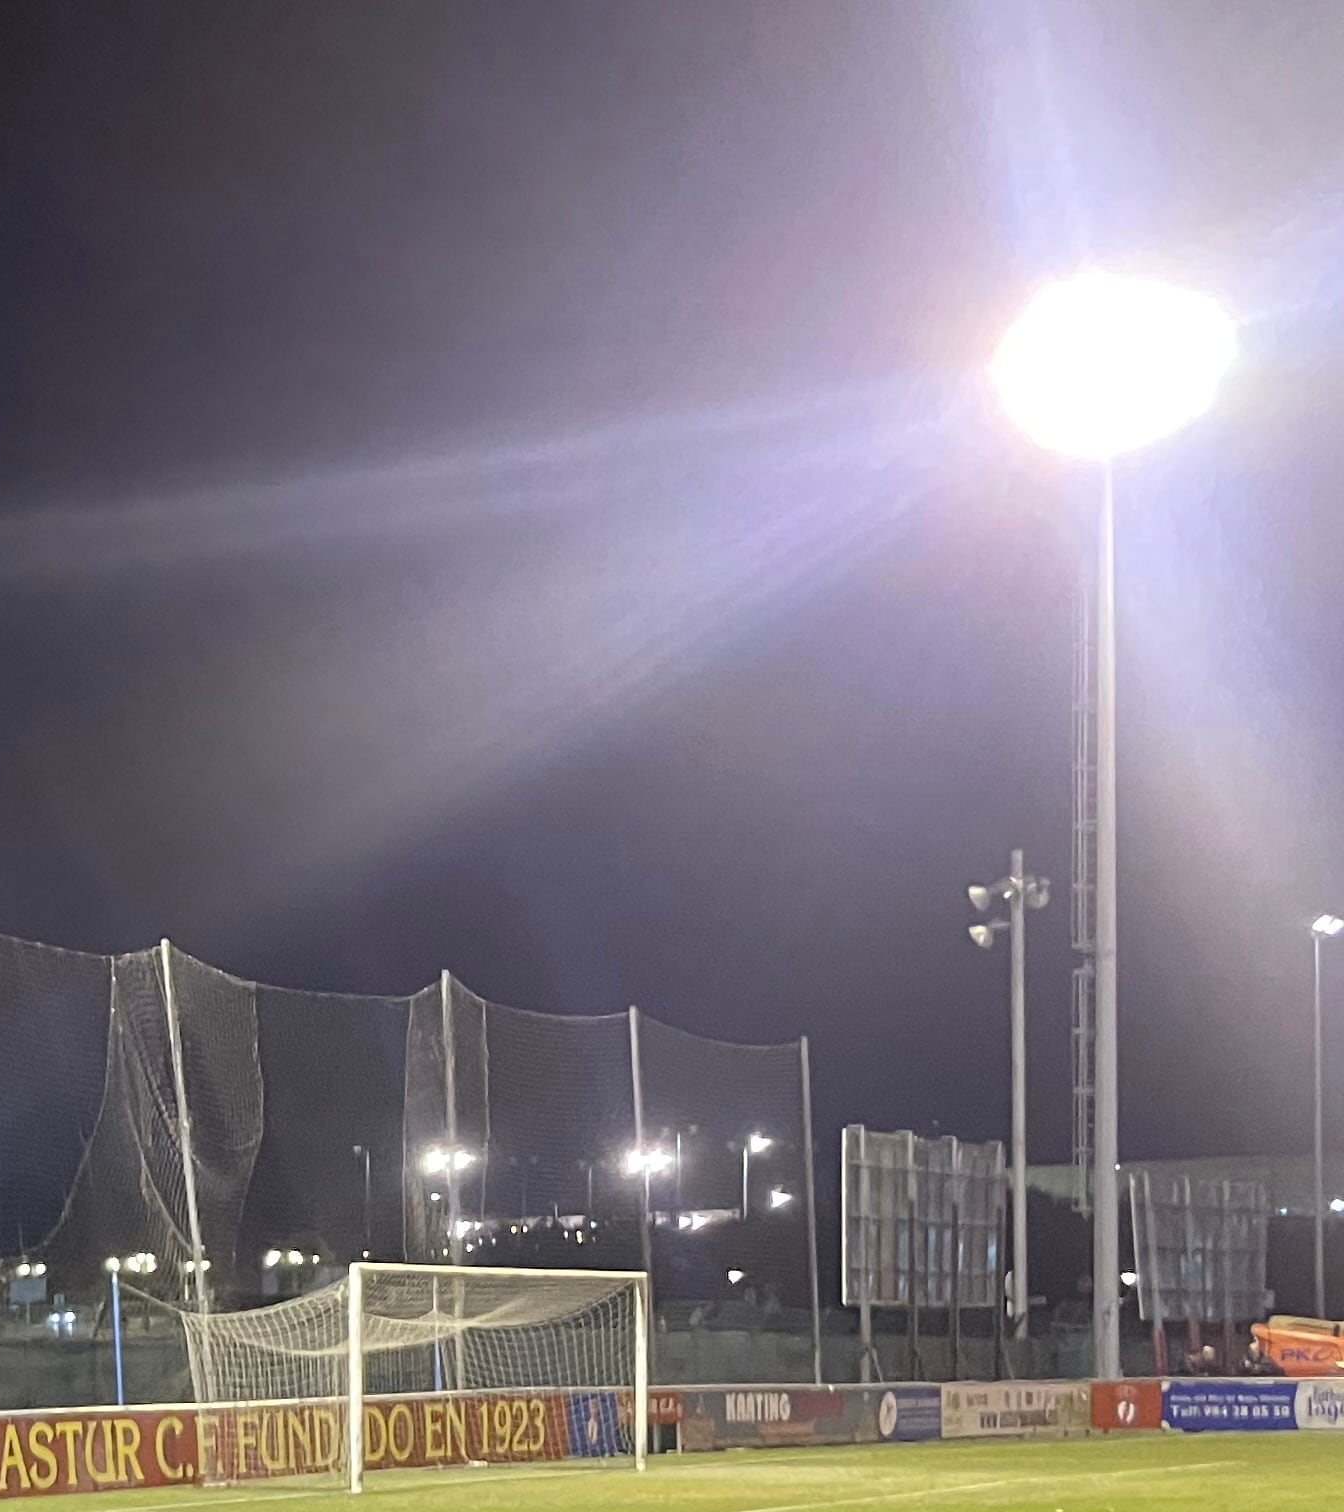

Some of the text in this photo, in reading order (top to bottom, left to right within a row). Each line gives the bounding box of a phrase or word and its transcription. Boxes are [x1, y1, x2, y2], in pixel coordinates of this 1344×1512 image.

[236, 1403, 415, 1474] FUNDDO
[424, 1401, 469, 1460] EN
[478, 1398, 546, 1455] 1923
